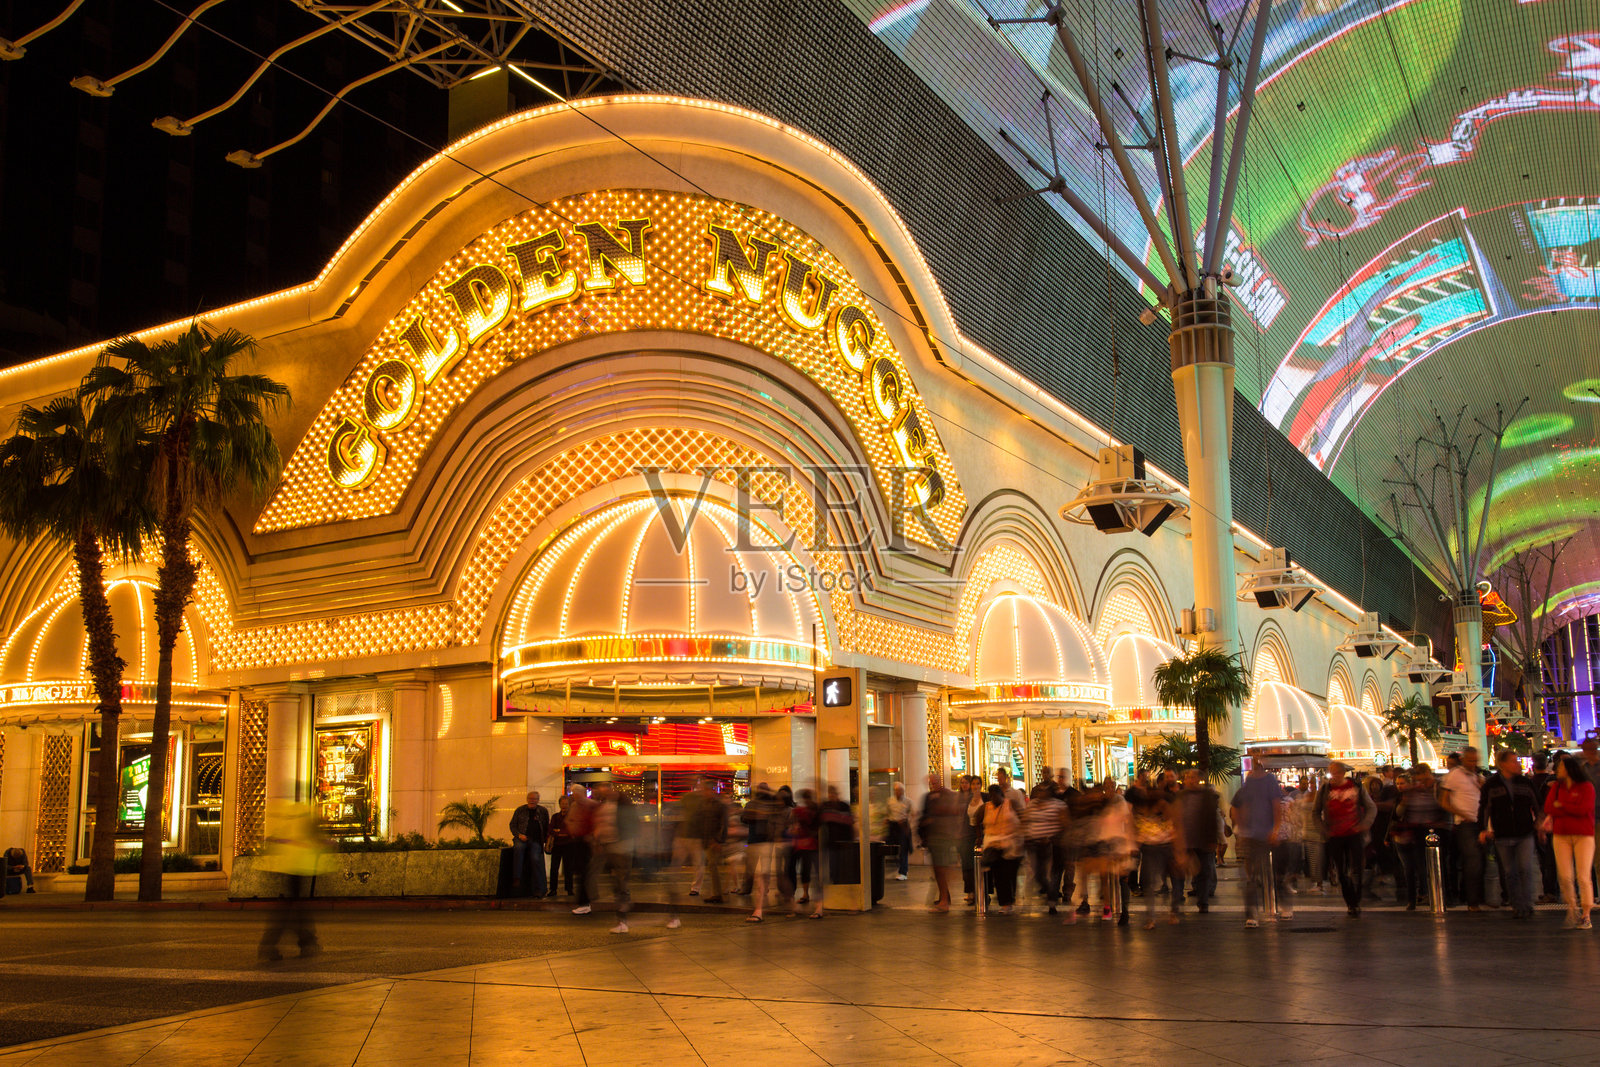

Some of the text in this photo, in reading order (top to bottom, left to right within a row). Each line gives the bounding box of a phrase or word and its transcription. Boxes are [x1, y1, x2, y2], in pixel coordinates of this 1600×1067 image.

[327, 218, 947, 513] GOLDEN NUGGET
[11, 685, 87, 701] NUGGET
